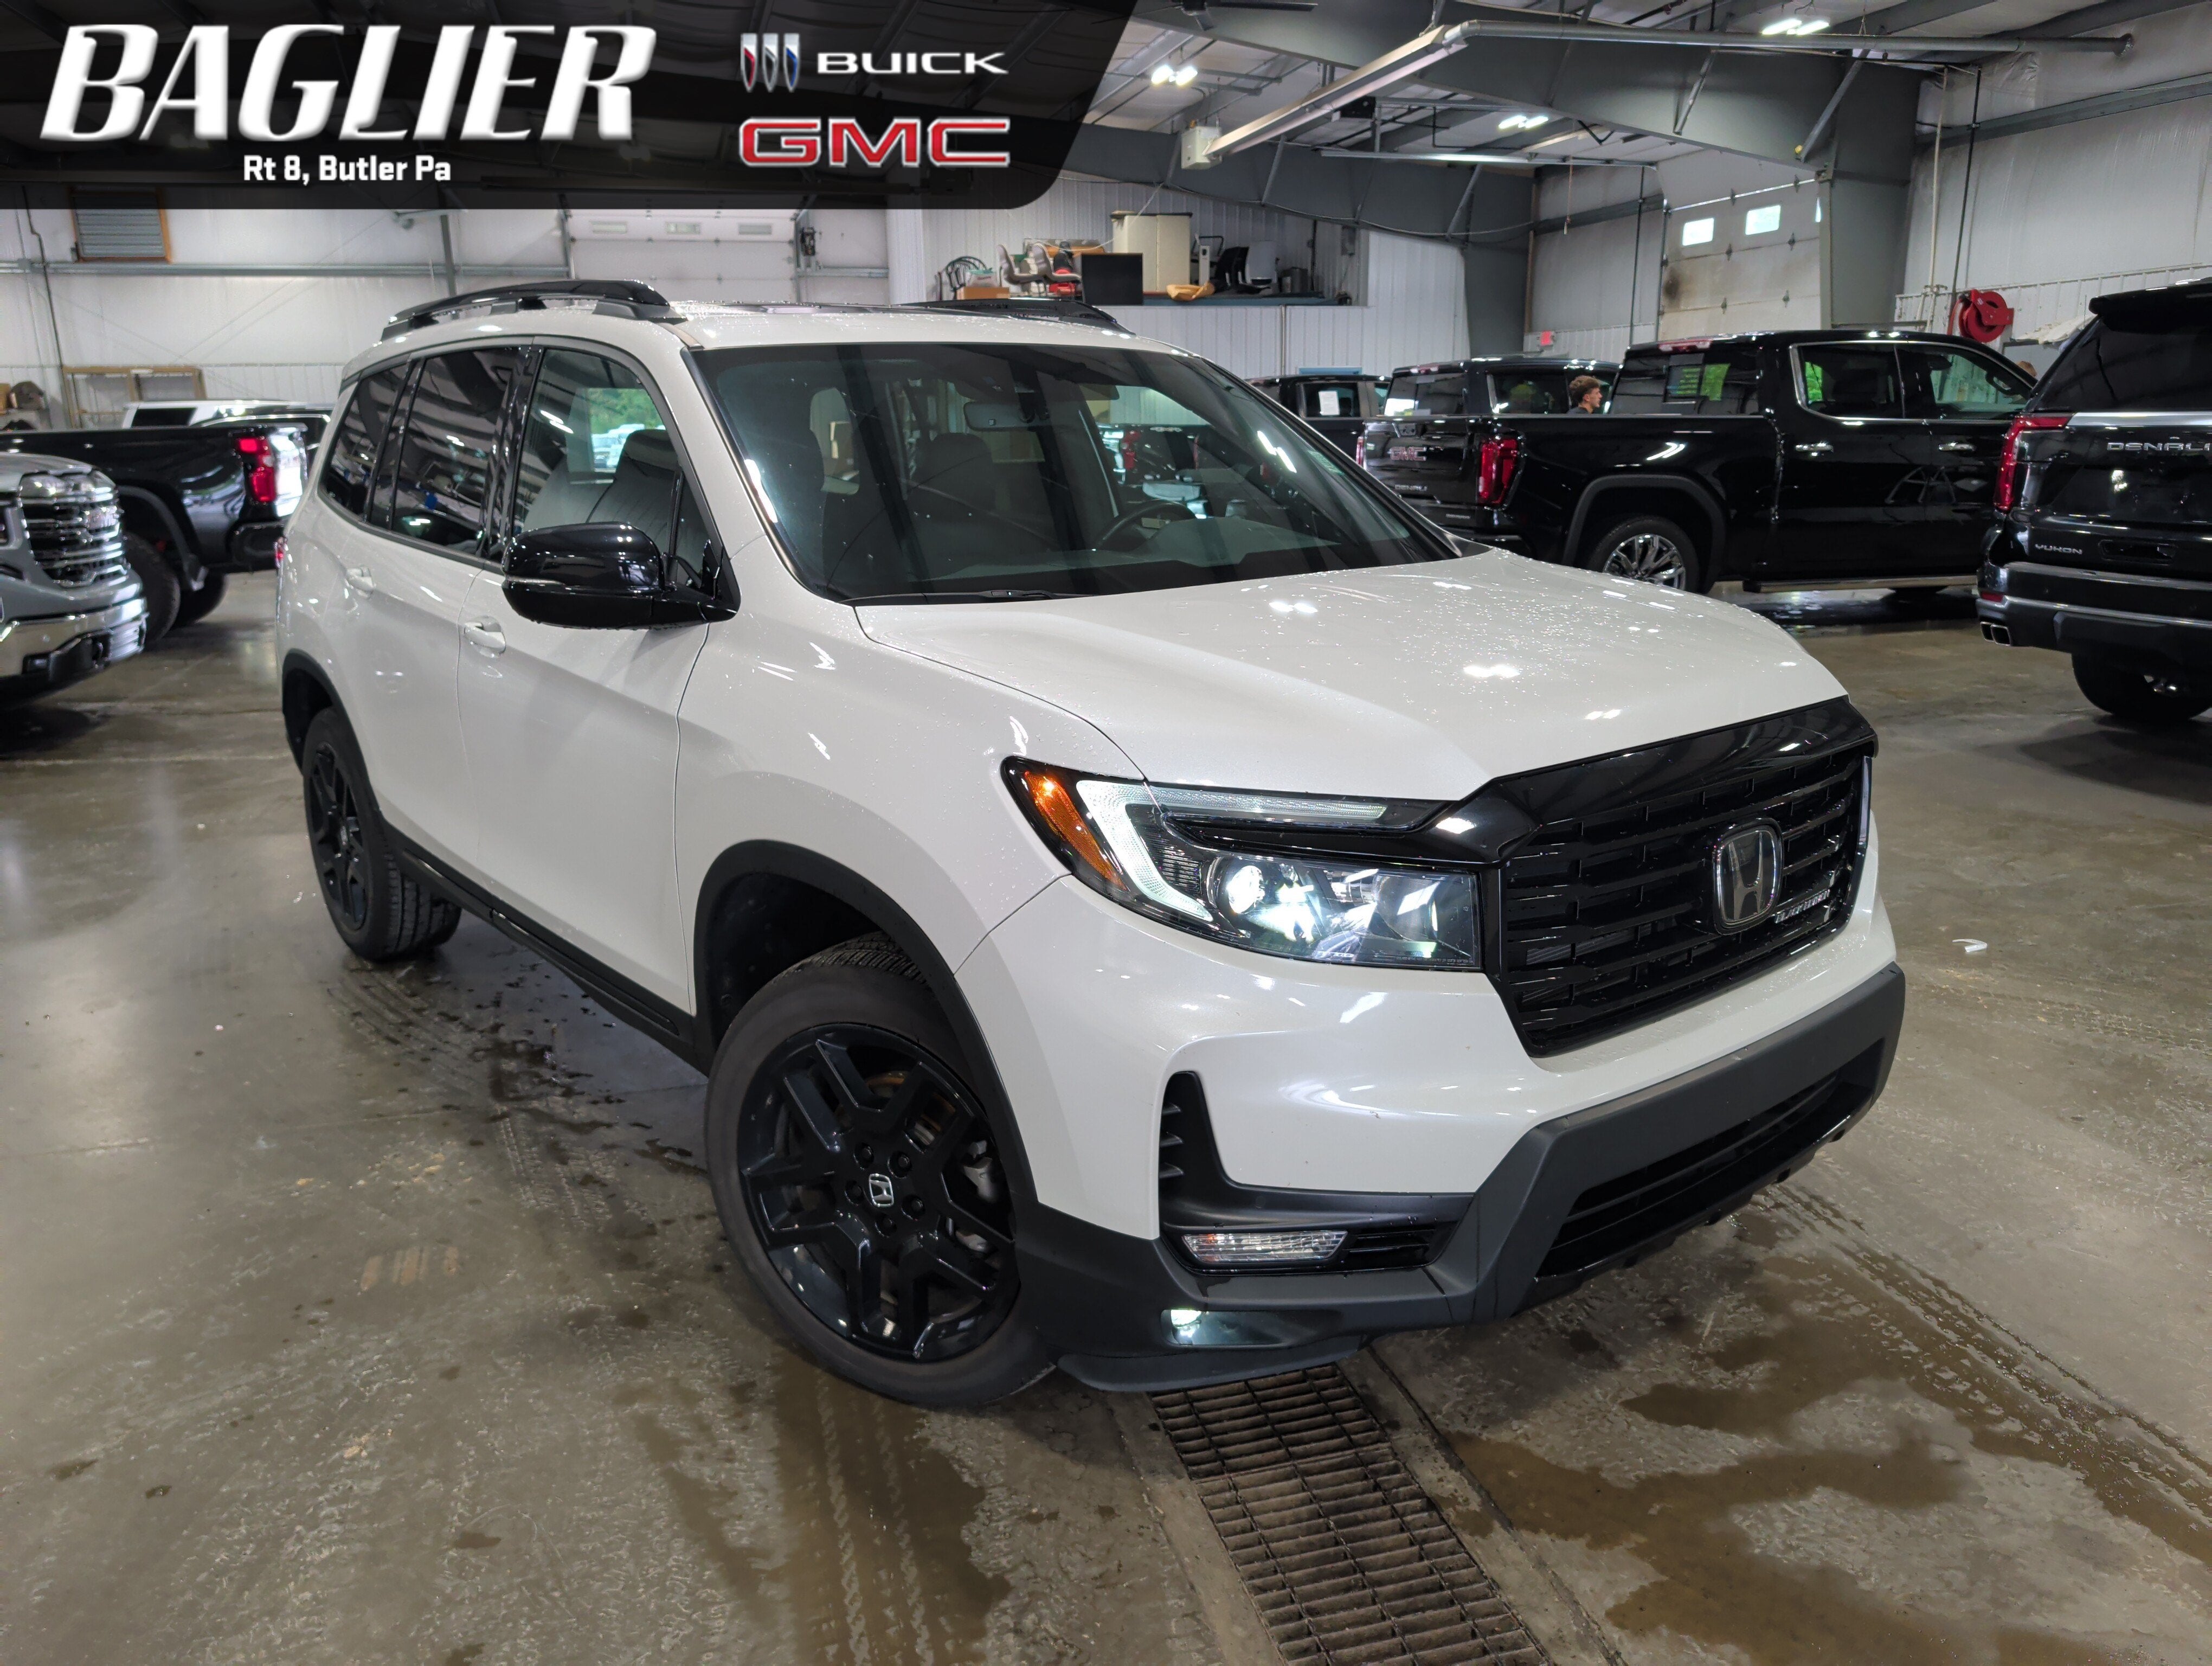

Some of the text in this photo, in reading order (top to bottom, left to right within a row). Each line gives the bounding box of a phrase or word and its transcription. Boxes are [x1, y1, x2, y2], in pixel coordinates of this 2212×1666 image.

[2107, 442, 2210, 451] DENALI
[1389, 446, 1427, 461] GMC
[2035, 543, 2082, 554] YUKON
